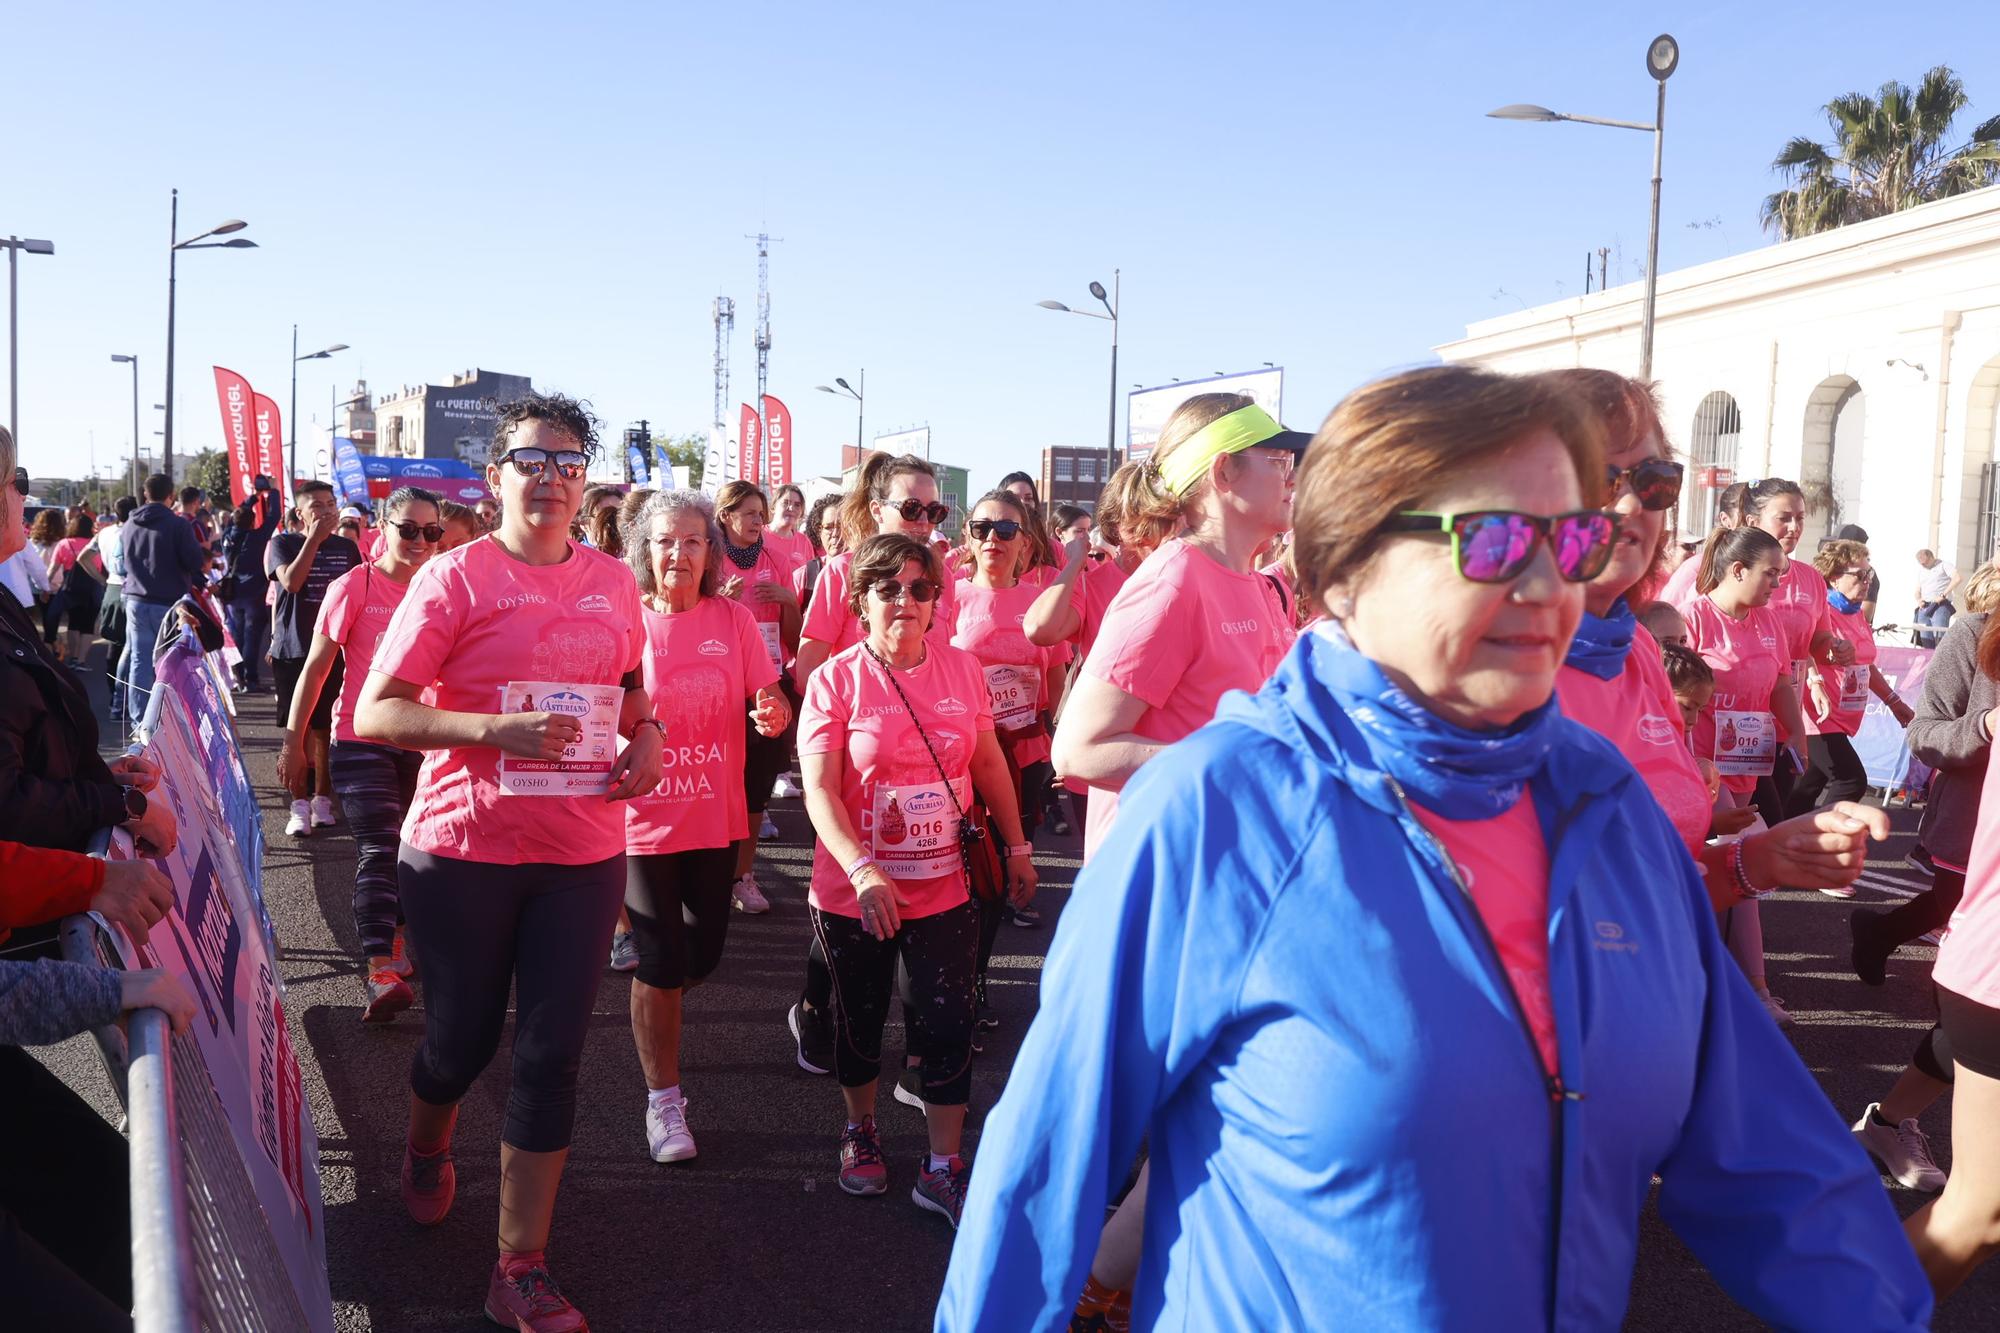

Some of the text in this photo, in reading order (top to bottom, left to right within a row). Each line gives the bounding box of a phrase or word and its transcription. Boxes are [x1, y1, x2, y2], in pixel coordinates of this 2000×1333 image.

[436, 399, 481, 410] EL PUERTO
[497, 594, 546, 610] OYSHO
[995, 688, 1017, 702] 016
[545, 701, 588, 713] ASTURIANA
[861, 704, 904, 717] OYSHO
[1738, 737, 1759, 747] 016
[512, 778, 549, 787] OYSHO
[910, 820, 943, 836] 016
[917, 837, 938, 848] 4268
[883, 865, 916, 873] OYSHO
